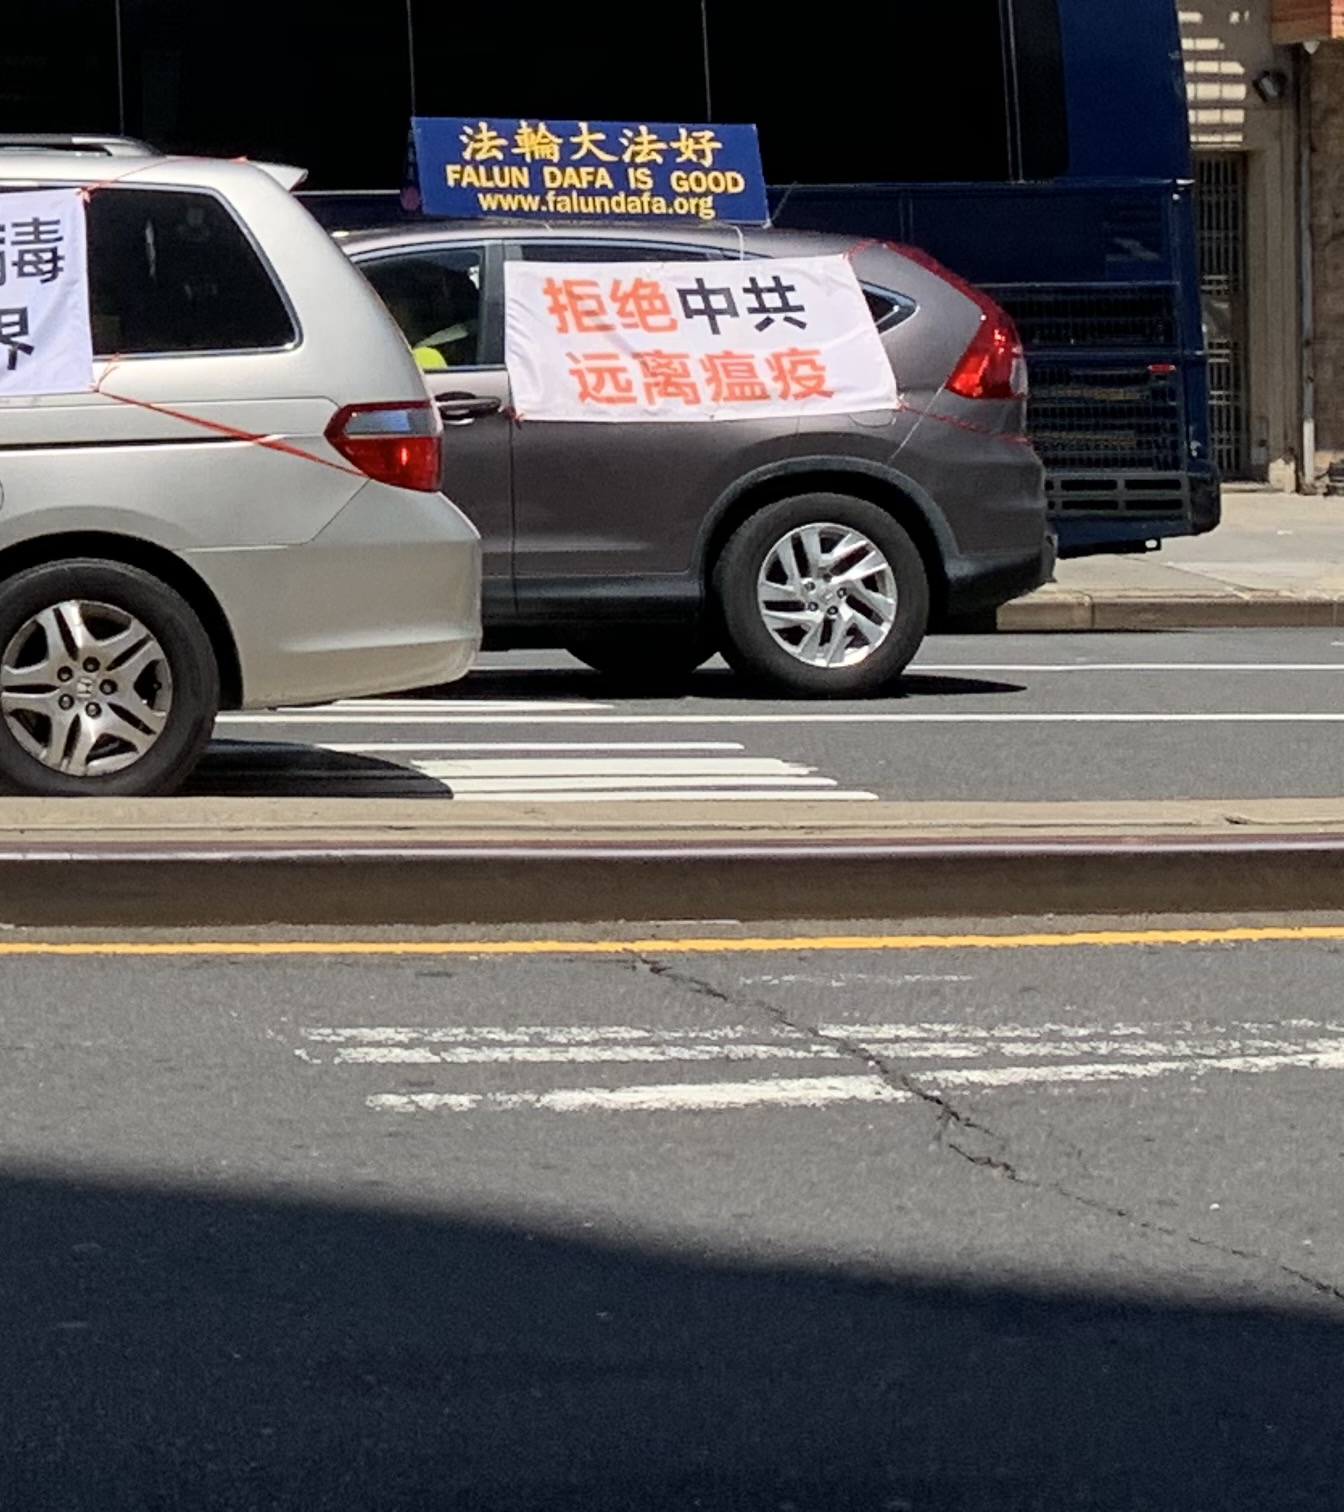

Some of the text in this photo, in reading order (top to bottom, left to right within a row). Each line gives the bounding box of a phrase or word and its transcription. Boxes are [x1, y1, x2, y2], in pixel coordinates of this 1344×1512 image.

[459, 120, 724, 168] 法輪大法好
[445, 164, 746, 195] FALUN DAFA IS GOOD
[477, 190, 716, 219] www.falundafa.org
[541, 274, 809, 336] 拒绝中共
[565, 346, 835, 406] 远离瘟疫
